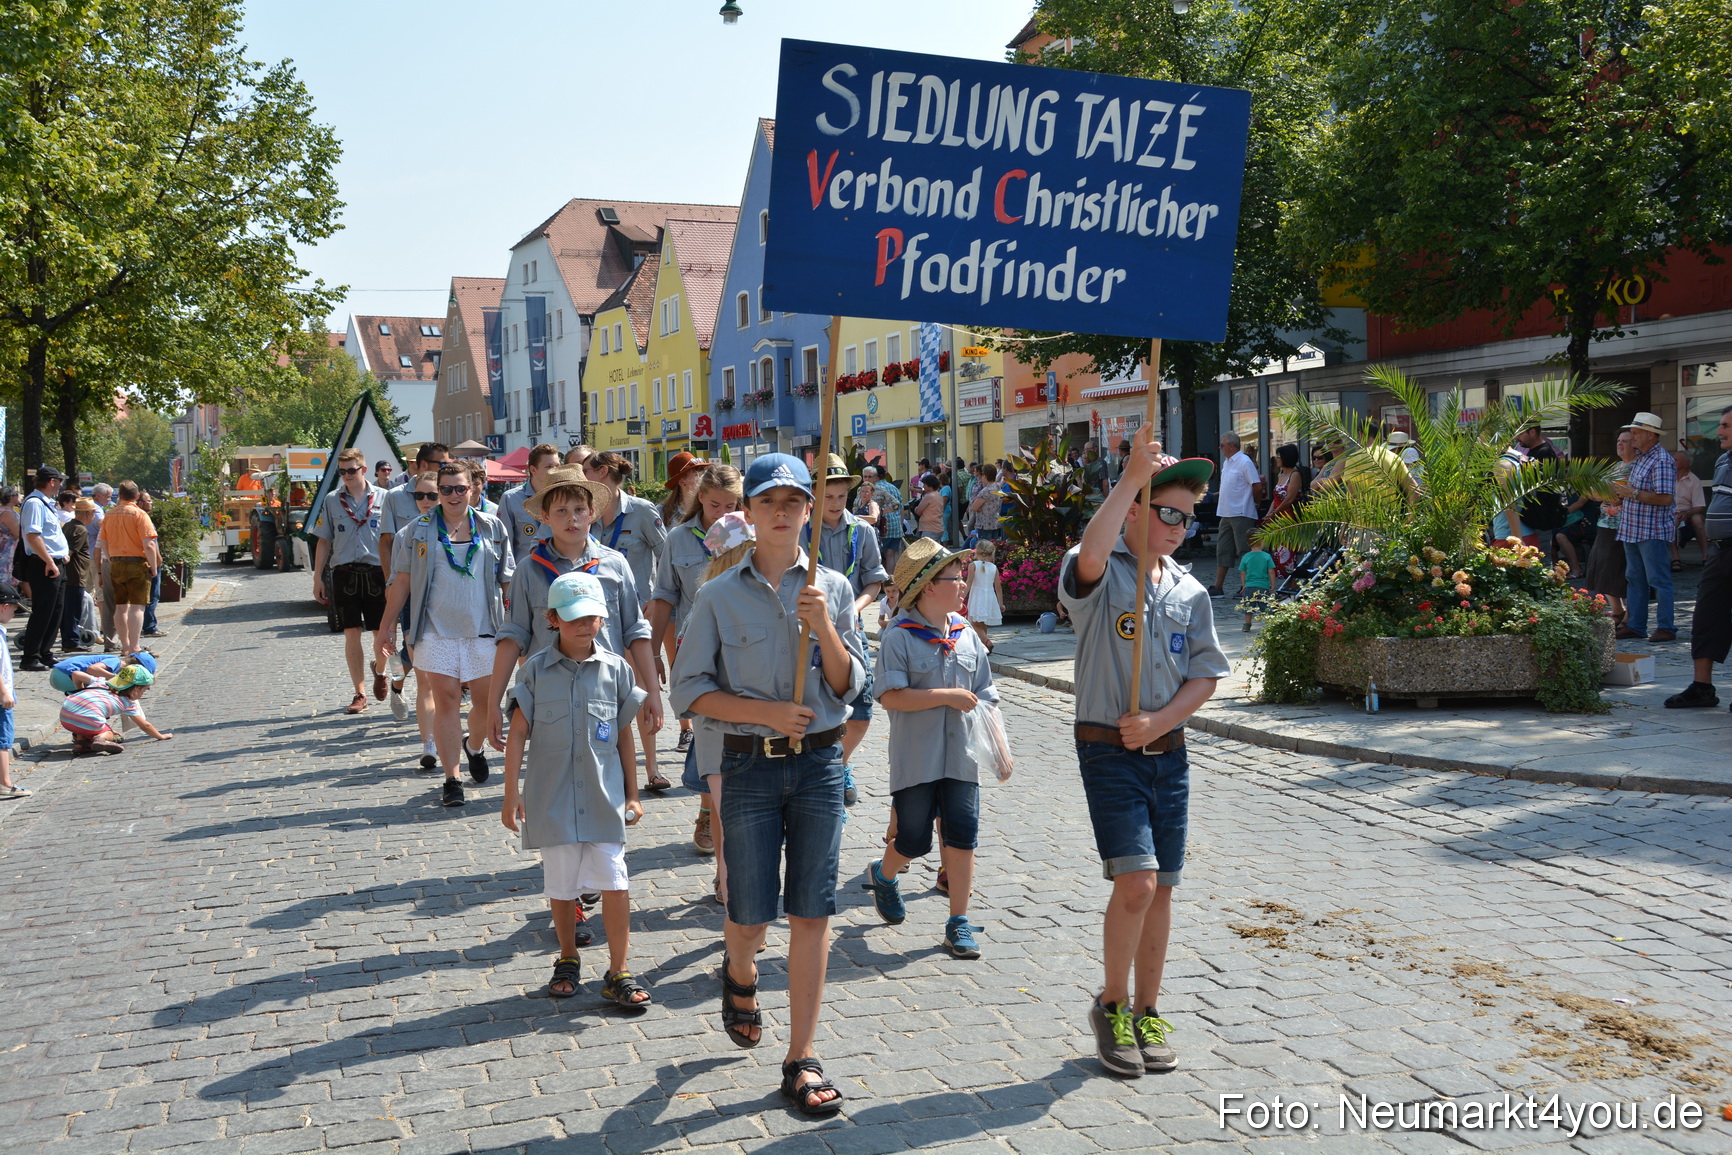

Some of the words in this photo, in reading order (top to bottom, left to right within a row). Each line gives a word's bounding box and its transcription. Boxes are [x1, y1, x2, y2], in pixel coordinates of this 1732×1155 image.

[816, 62, 1060, 156] SIEDLUNG
[1074, 91, 1207, 171] TAIZÉ
[807, 148, 983, 221] Verband
[993, 169, 1219, 241] Christlicher
[874, 227, 1127, 306] Pfadfinder
[608, 368, 624, 383] HOTEL
